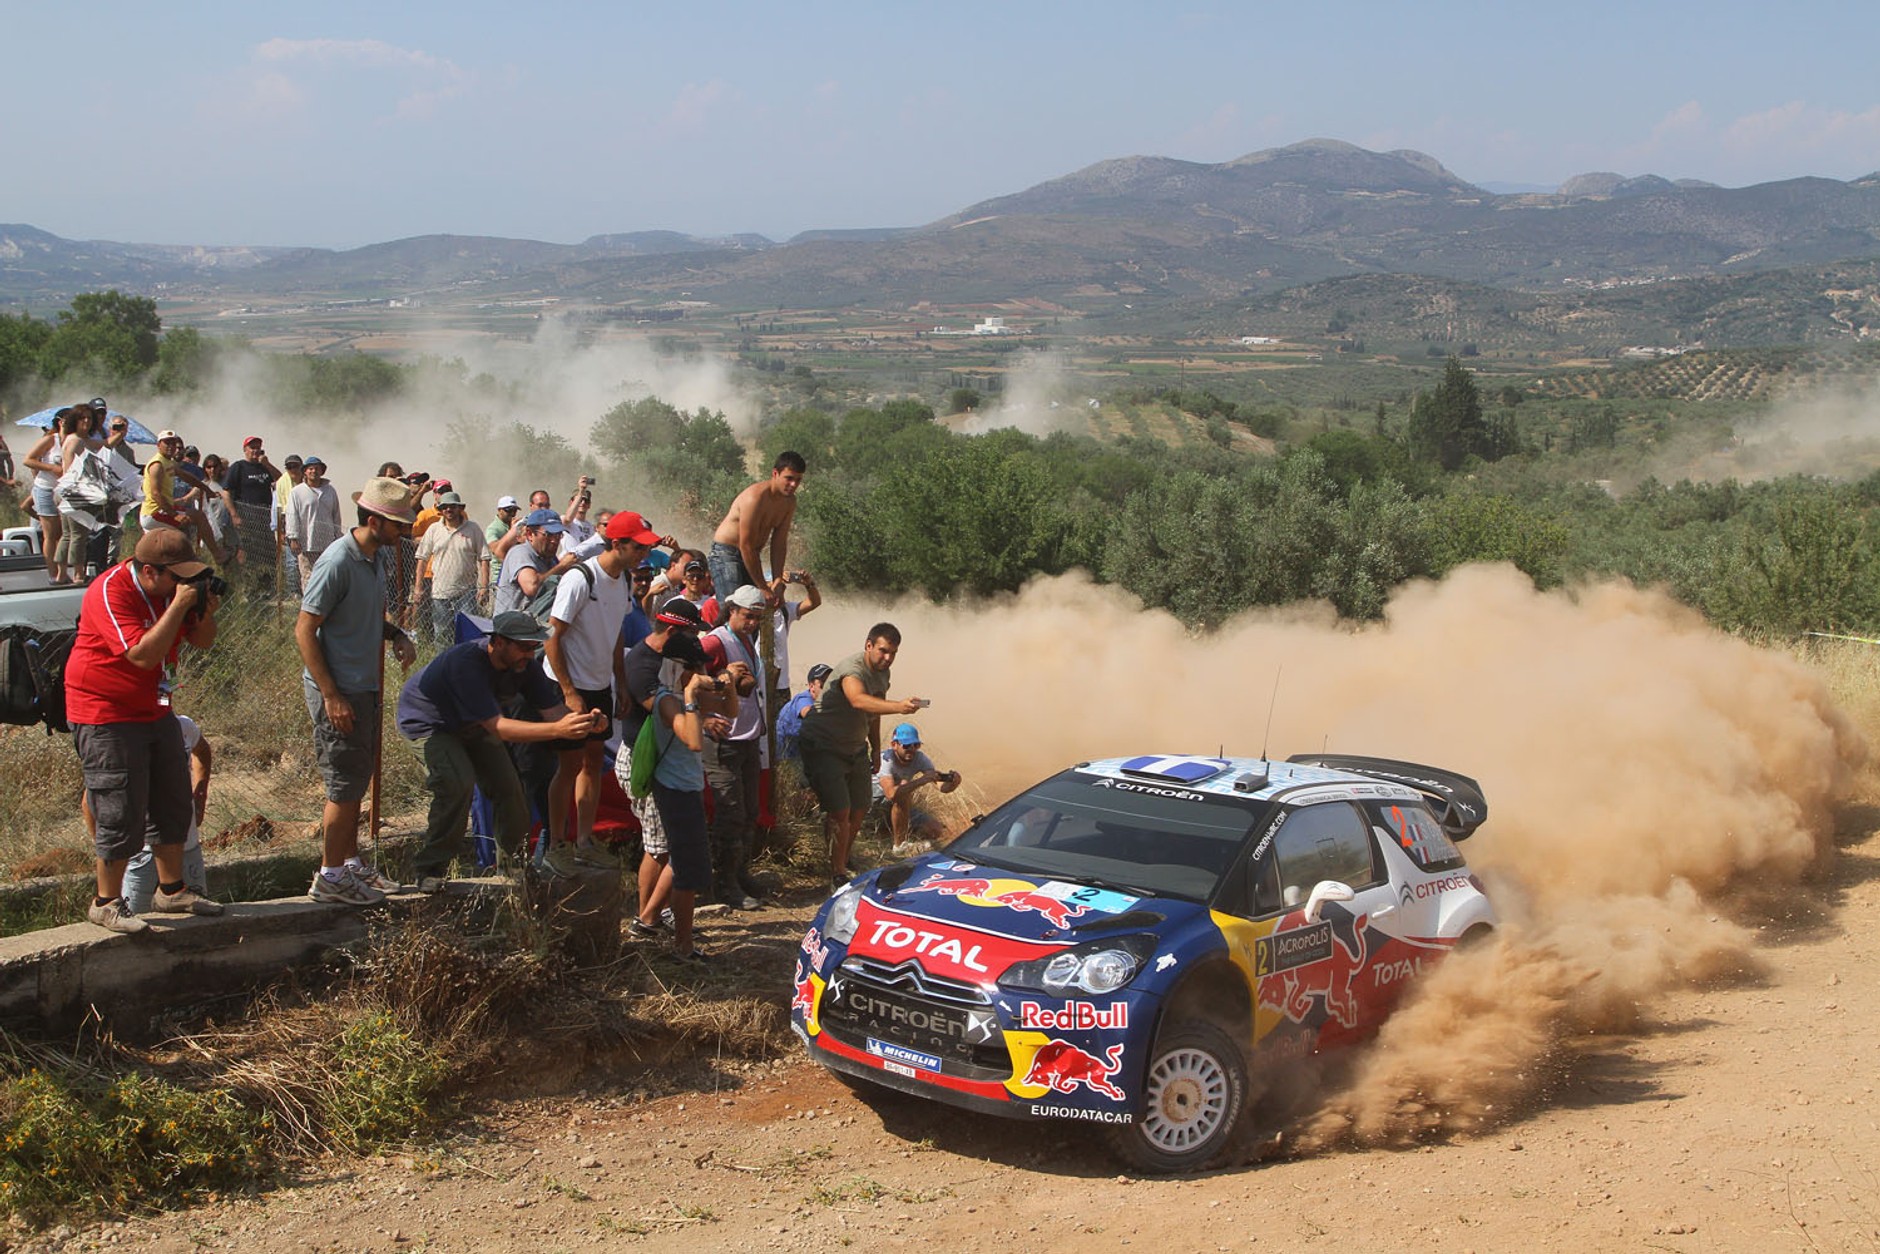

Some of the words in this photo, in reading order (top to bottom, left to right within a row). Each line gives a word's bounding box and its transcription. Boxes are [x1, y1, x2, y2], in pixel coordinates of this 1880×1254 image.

[1391, 805, 1413, 848] 2
[1073, 888, 1101, 902] 2
[869, 919, 989, 973] TOTAL
[1278, 926, 1329, 956] ACROPOLIS
[1258, 940, 1269, 976] 2
[1021, 1000, 1074, 1030] Red
[1076, 1002, 1128, 1030] Bull
[884, 1046, 938, 1067] MICHELIN
[1031, 1104, 1133, 1124] EURODATACAR
